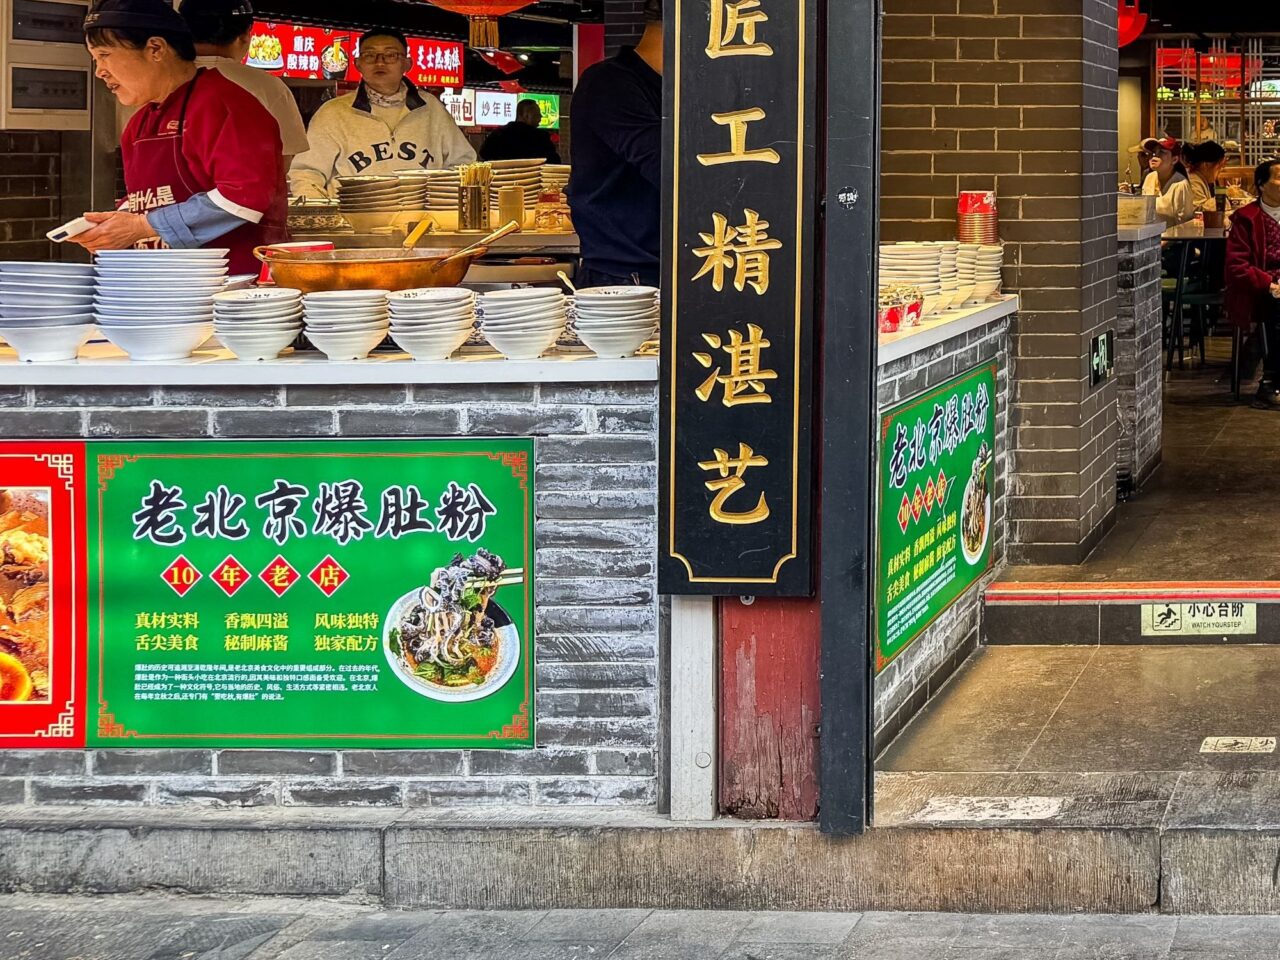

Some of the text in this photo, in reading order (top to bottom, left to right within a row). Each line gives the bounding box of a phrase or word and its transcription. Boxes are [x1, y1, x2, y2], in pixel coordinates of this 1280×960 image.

[293, 36, 315, 52] 重庆
[287, 53, 320, 71] 酸辣粉
[444, 97, 473, 122] 煎包
[481, 101, 512, 117] 炒年糕
[348, 141, 435, 174] BEST
[889, 382, 990, 490] 老北京爆肚粉
[131, 478, 498, 546] 老北京爆肚粉
[168, 564, 342, 589] 10年老店
[1188, 603, 1244, 618] 小心台阶
[134, 611, 379, 630] 真材实料 香飘四溢 风味独特
[134, 633, 379, 652] 舌尖美食 秘制麻酱 独家配方
